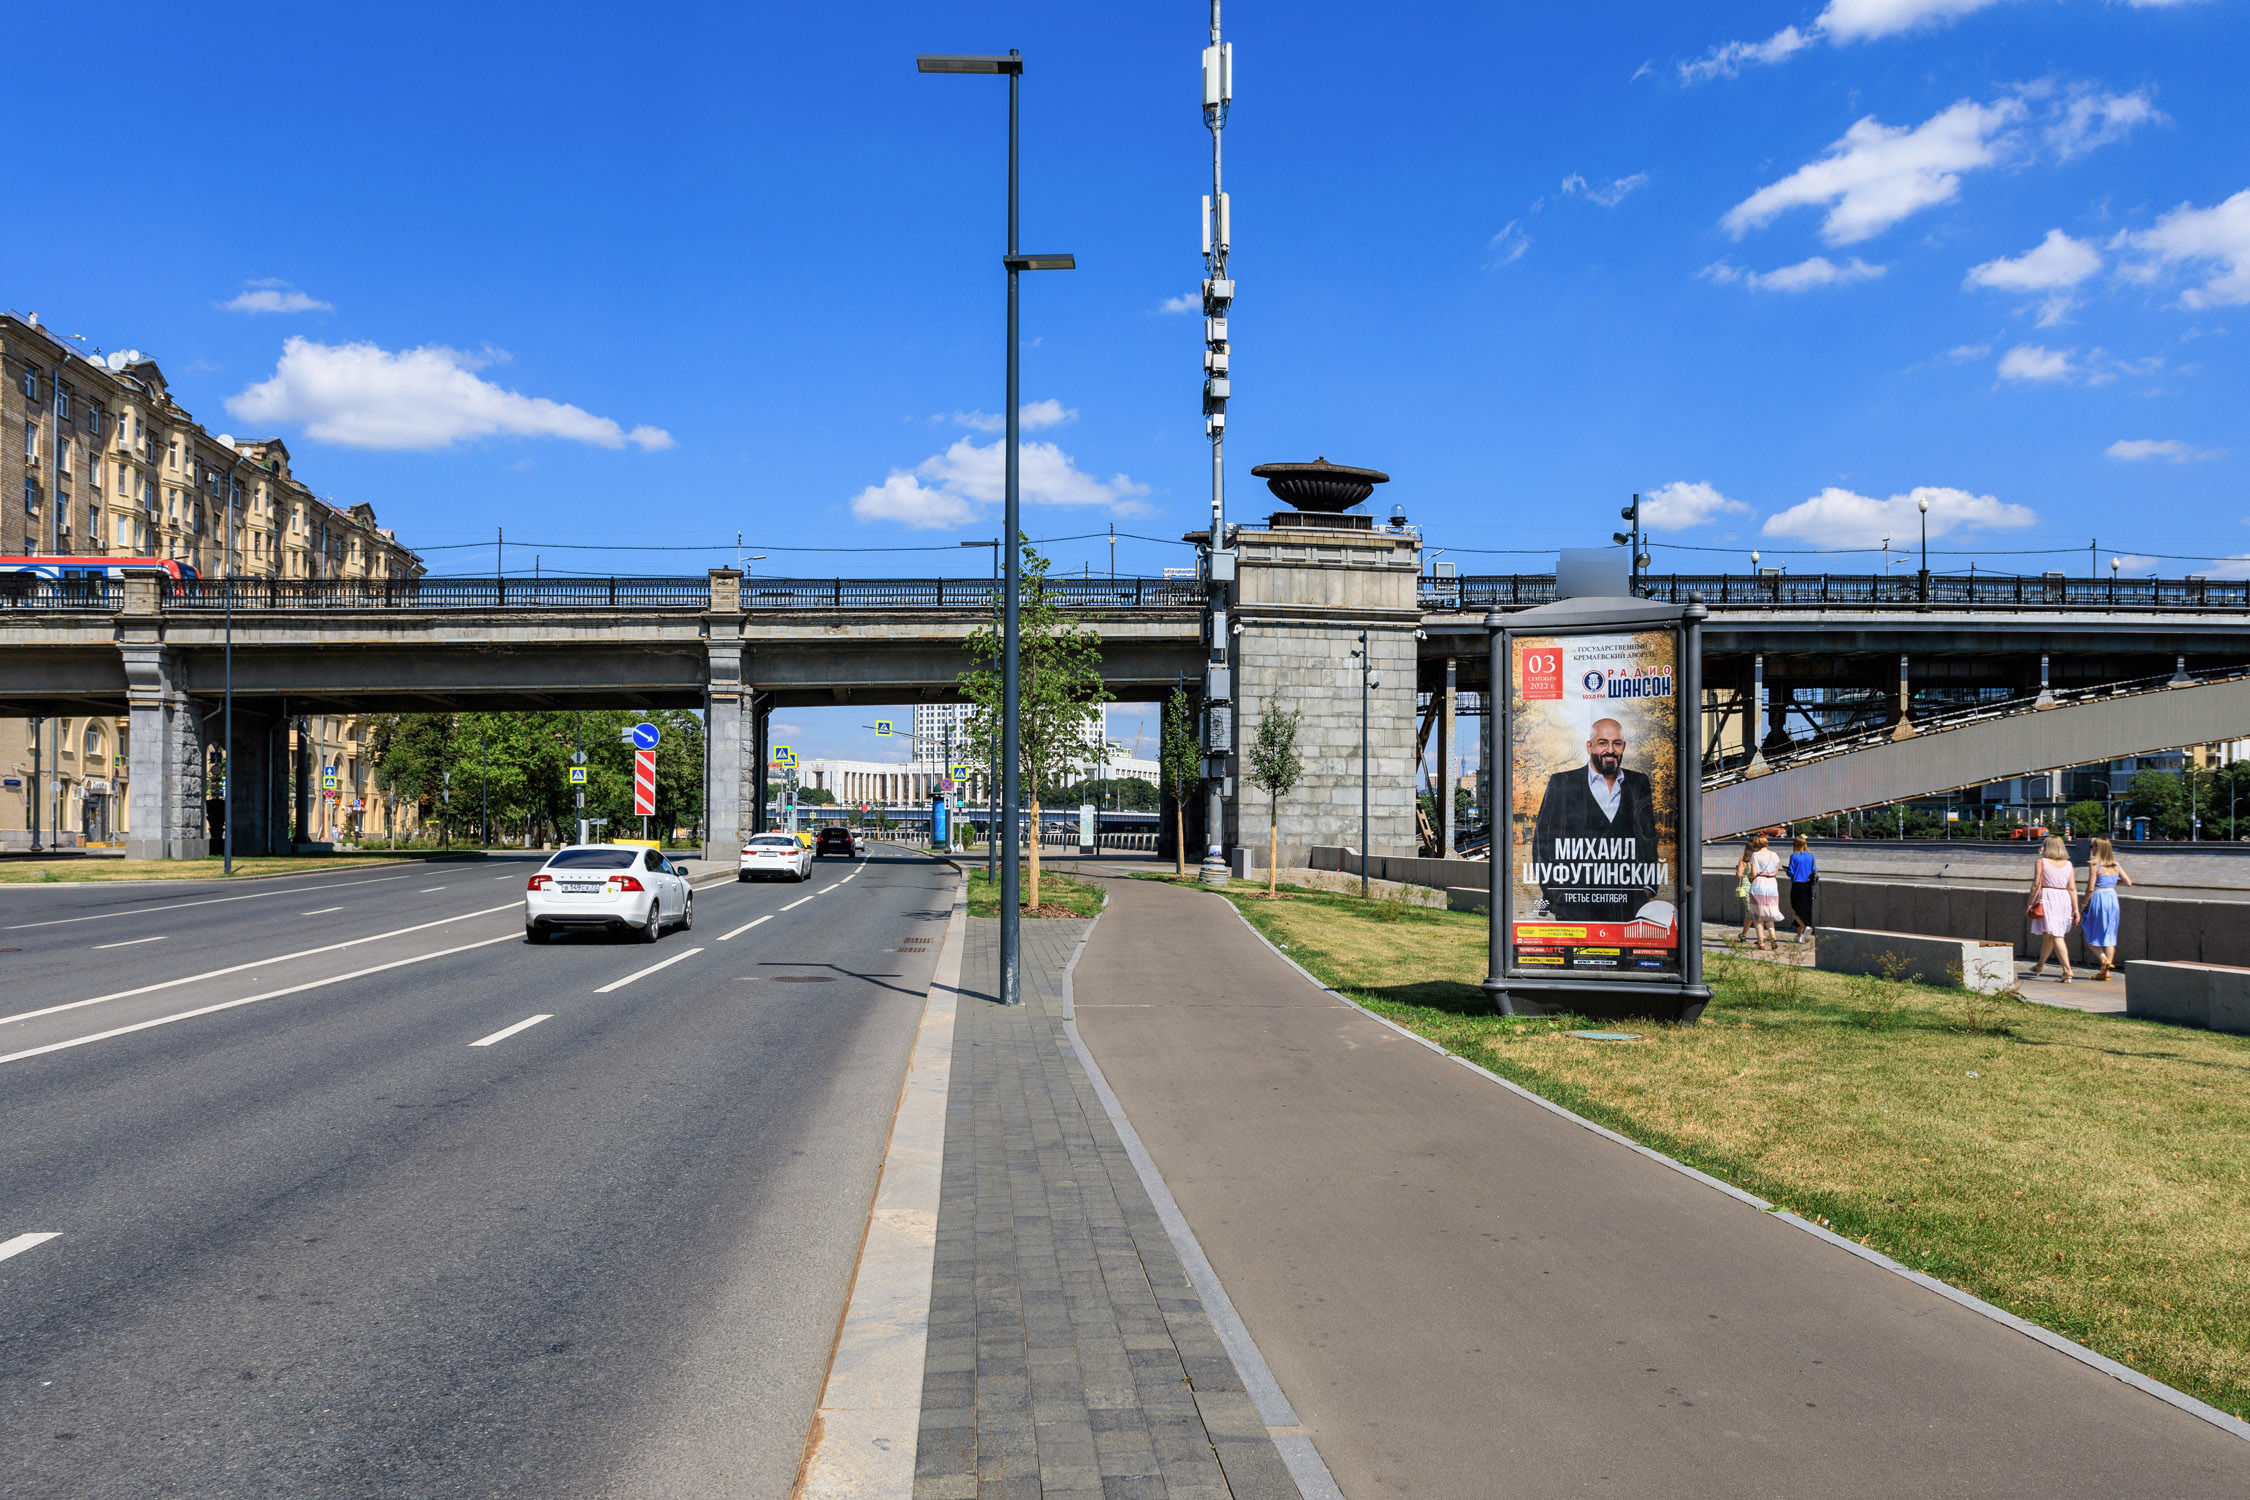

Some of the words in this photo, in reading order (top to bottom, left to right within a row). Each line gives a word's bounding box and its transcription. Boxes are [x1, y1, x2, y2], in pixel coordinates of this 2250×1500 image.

[1528, 654, 1556, 674] 03
[1608, 665, 1671, 678] РАДИО
[1529, 682, 1549, 690] 2022
[1608, 676, 1671, 699] ШАНСОН
[1554, 837, 1636, 860] МИХАИЛ
[1522, 858, 1669, 885] ШУФУТИНСКИЙ
[1564, 893, 1590, 903] ТРЕТЬЕ
[1591, 893, 1628, 903] СЕНТЯБРЯ
